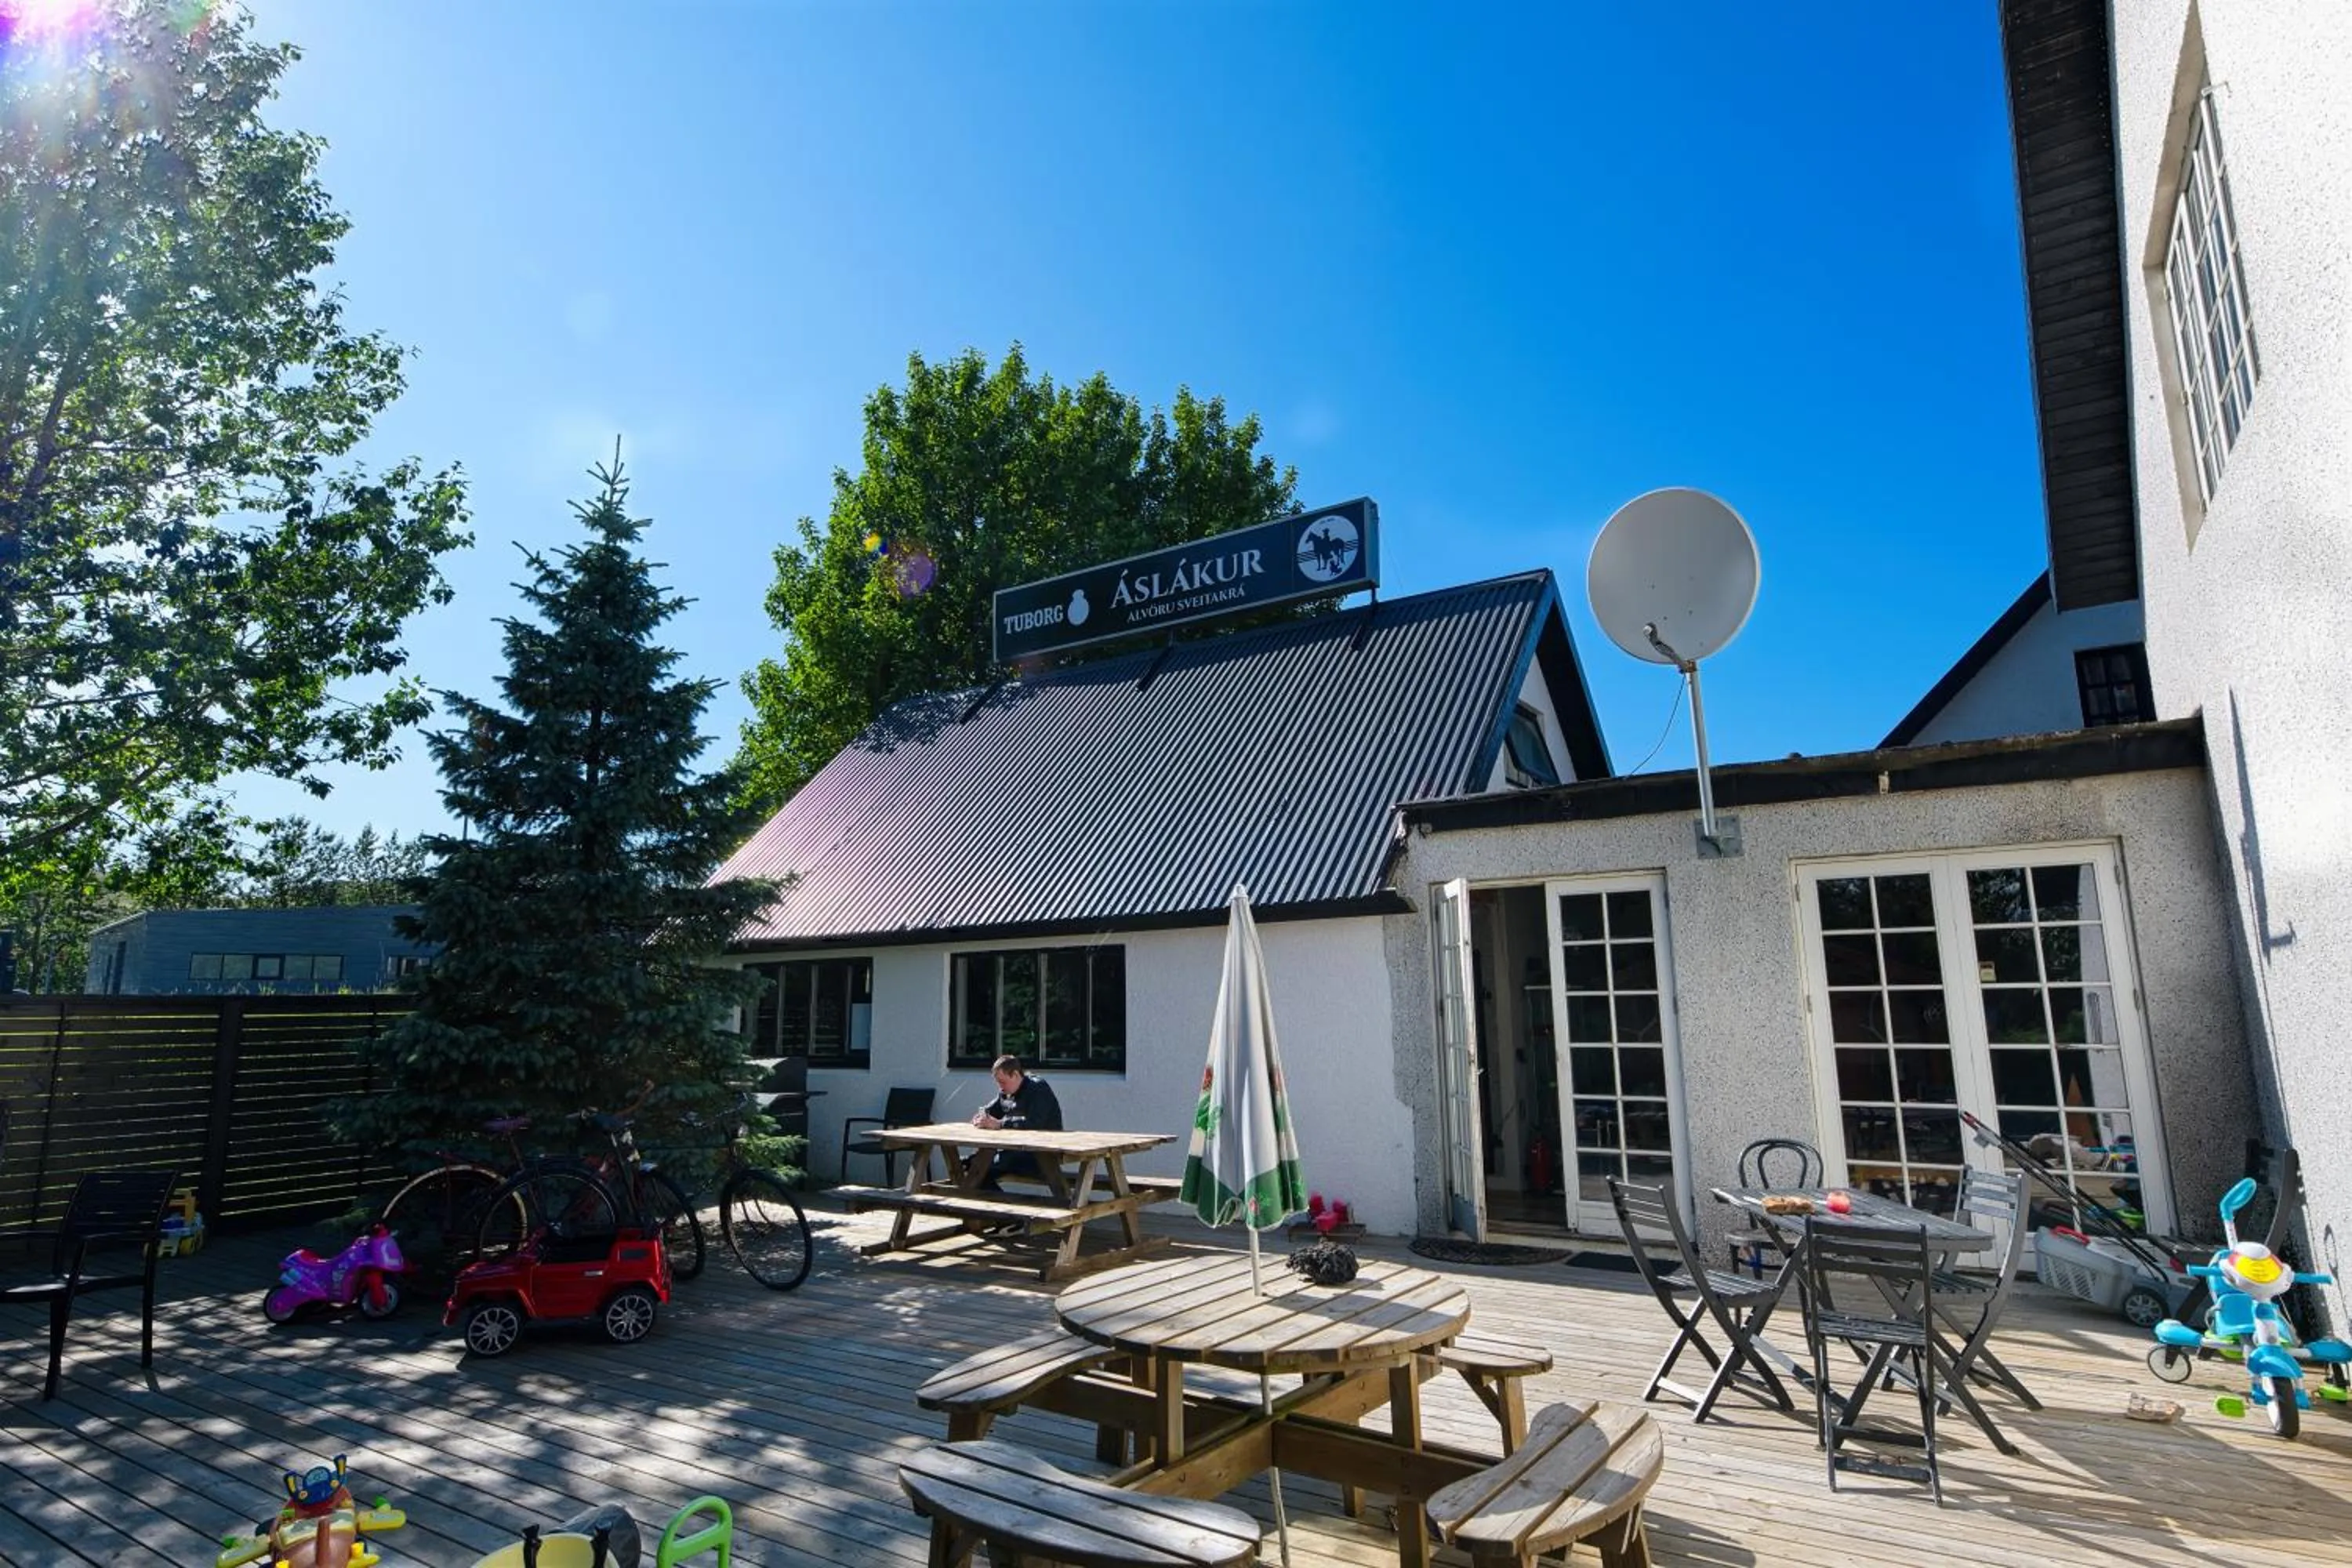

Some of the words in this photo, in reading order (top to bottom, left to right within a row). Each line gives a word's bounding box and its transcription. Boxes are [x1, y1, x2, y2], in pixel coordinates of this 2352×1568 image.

[1110, 549, 1267, 609] ÁSLÁKUR
[1004, 604, 1064, 634] TUBORG
[1127, 602, 1175, 623] ALVÖRU
